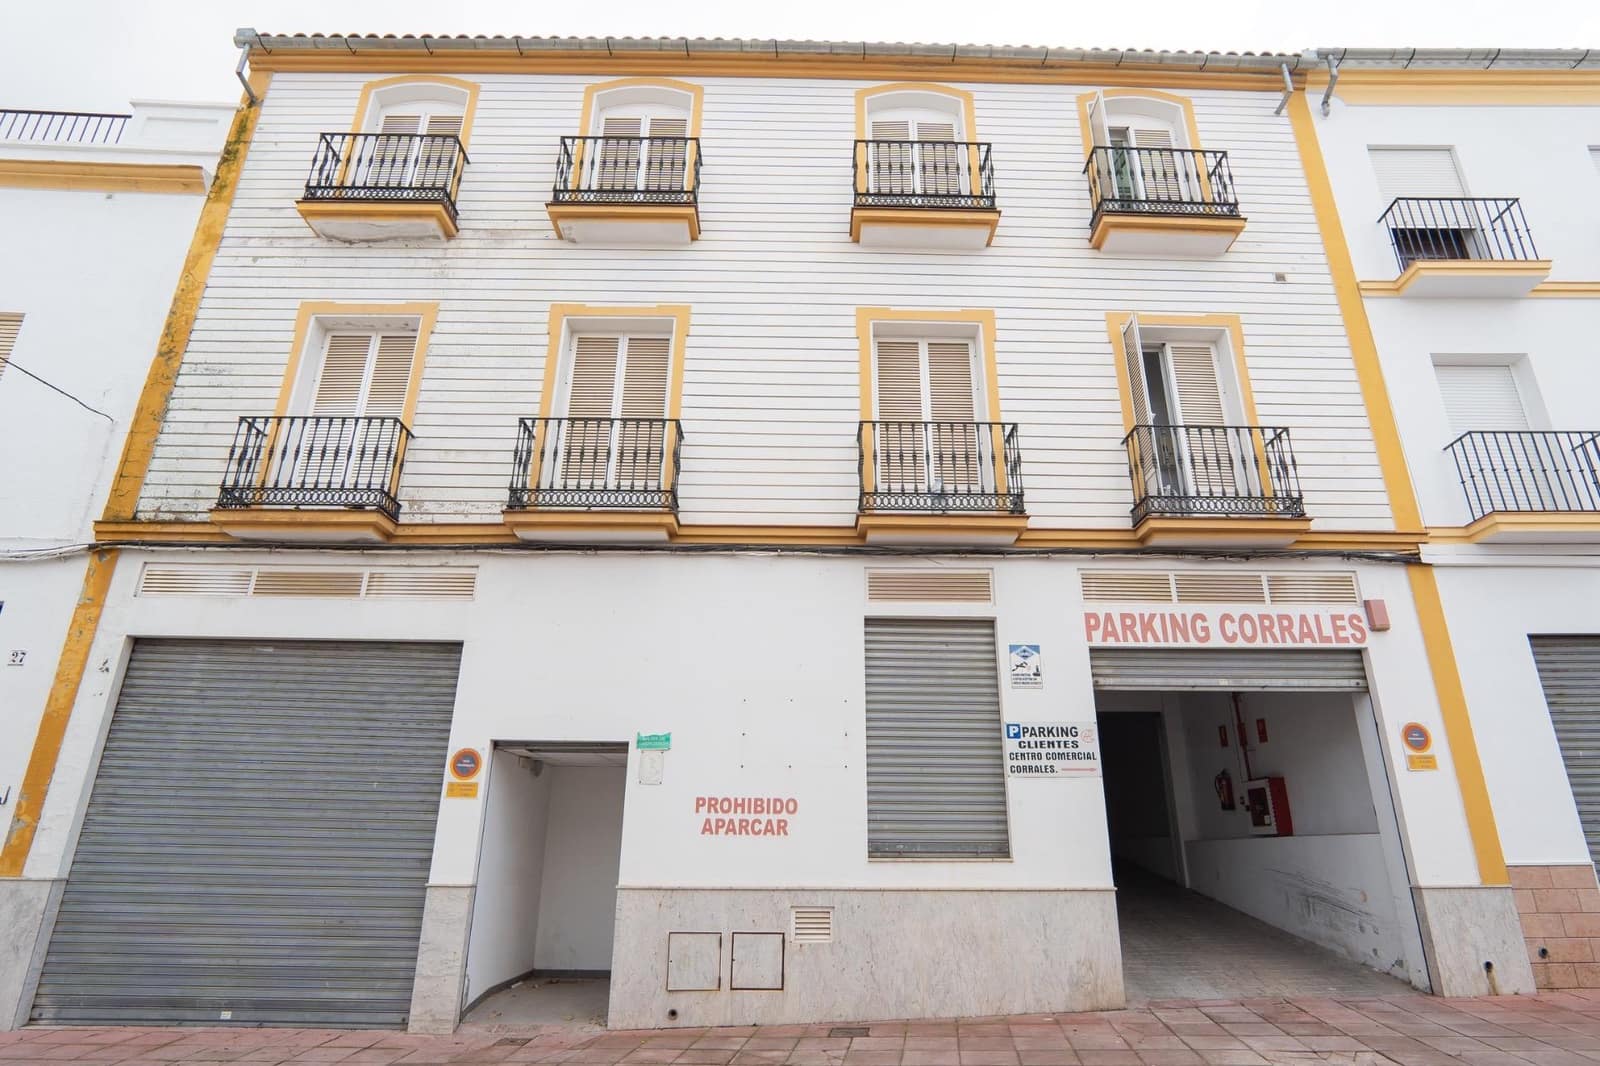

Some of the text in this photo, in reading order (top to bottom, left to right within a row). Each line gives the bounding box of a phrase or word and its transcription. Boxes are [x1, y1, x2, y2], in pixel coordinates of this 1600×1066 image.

[1084, 612, 1368, 644] PARKING CORRALES
[11, 651, 26, 663] 27
[1008, 725, 1020, 738] P
[1022, 726, 1079, 738] PARKING
[1018, 740, 1079, 749] CLIENTES
[1009, 752, 1097, 761] CENTRO COMERCIAL
[1010, 765, 1058, 774] CORRALES.
[695, 797, 798, 815] PROHIBIDO
[701, 818, 789, 836] APARCAR
